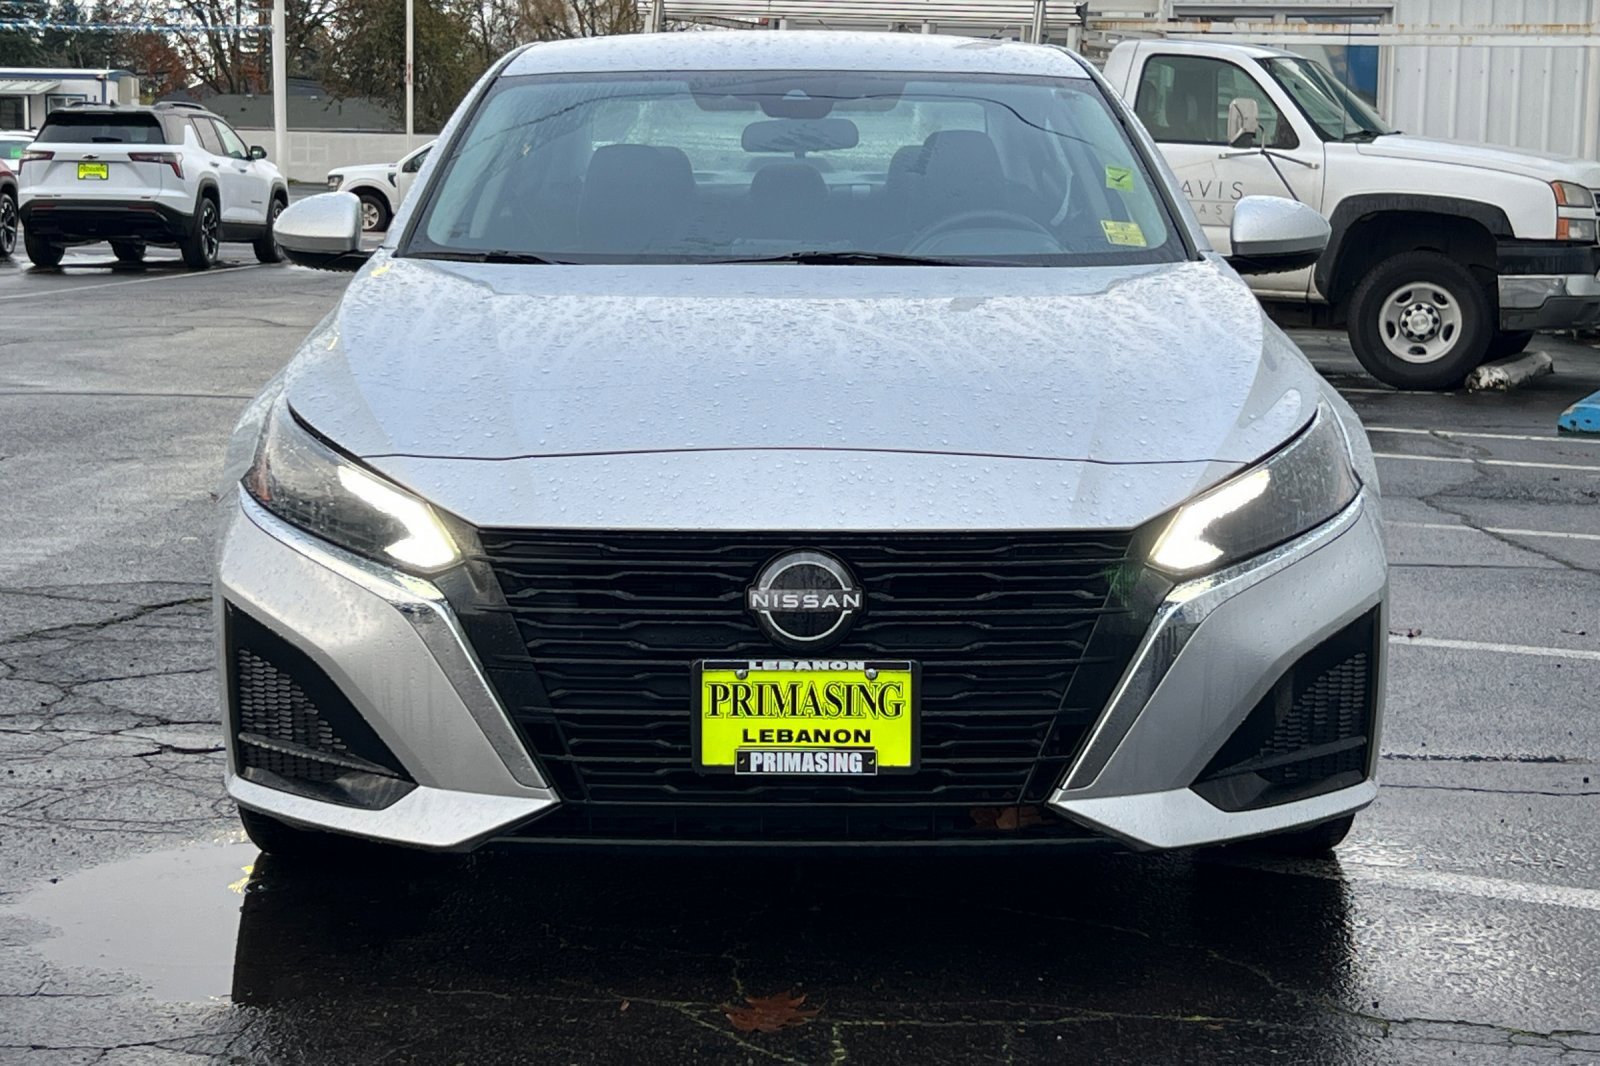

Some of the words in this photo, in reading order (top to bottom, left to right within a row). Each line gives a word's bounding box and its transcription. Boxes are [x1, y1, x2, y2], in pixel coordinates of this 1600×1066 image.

[752, 593, 860, 608] NISSAN
[748, 660, 865, 671] LEBANON
[705, 681, 906, 719] PRIMASING
[742, 728, 871, 743] LEBANON
[750, 752, 863, 773] PRIMASING
